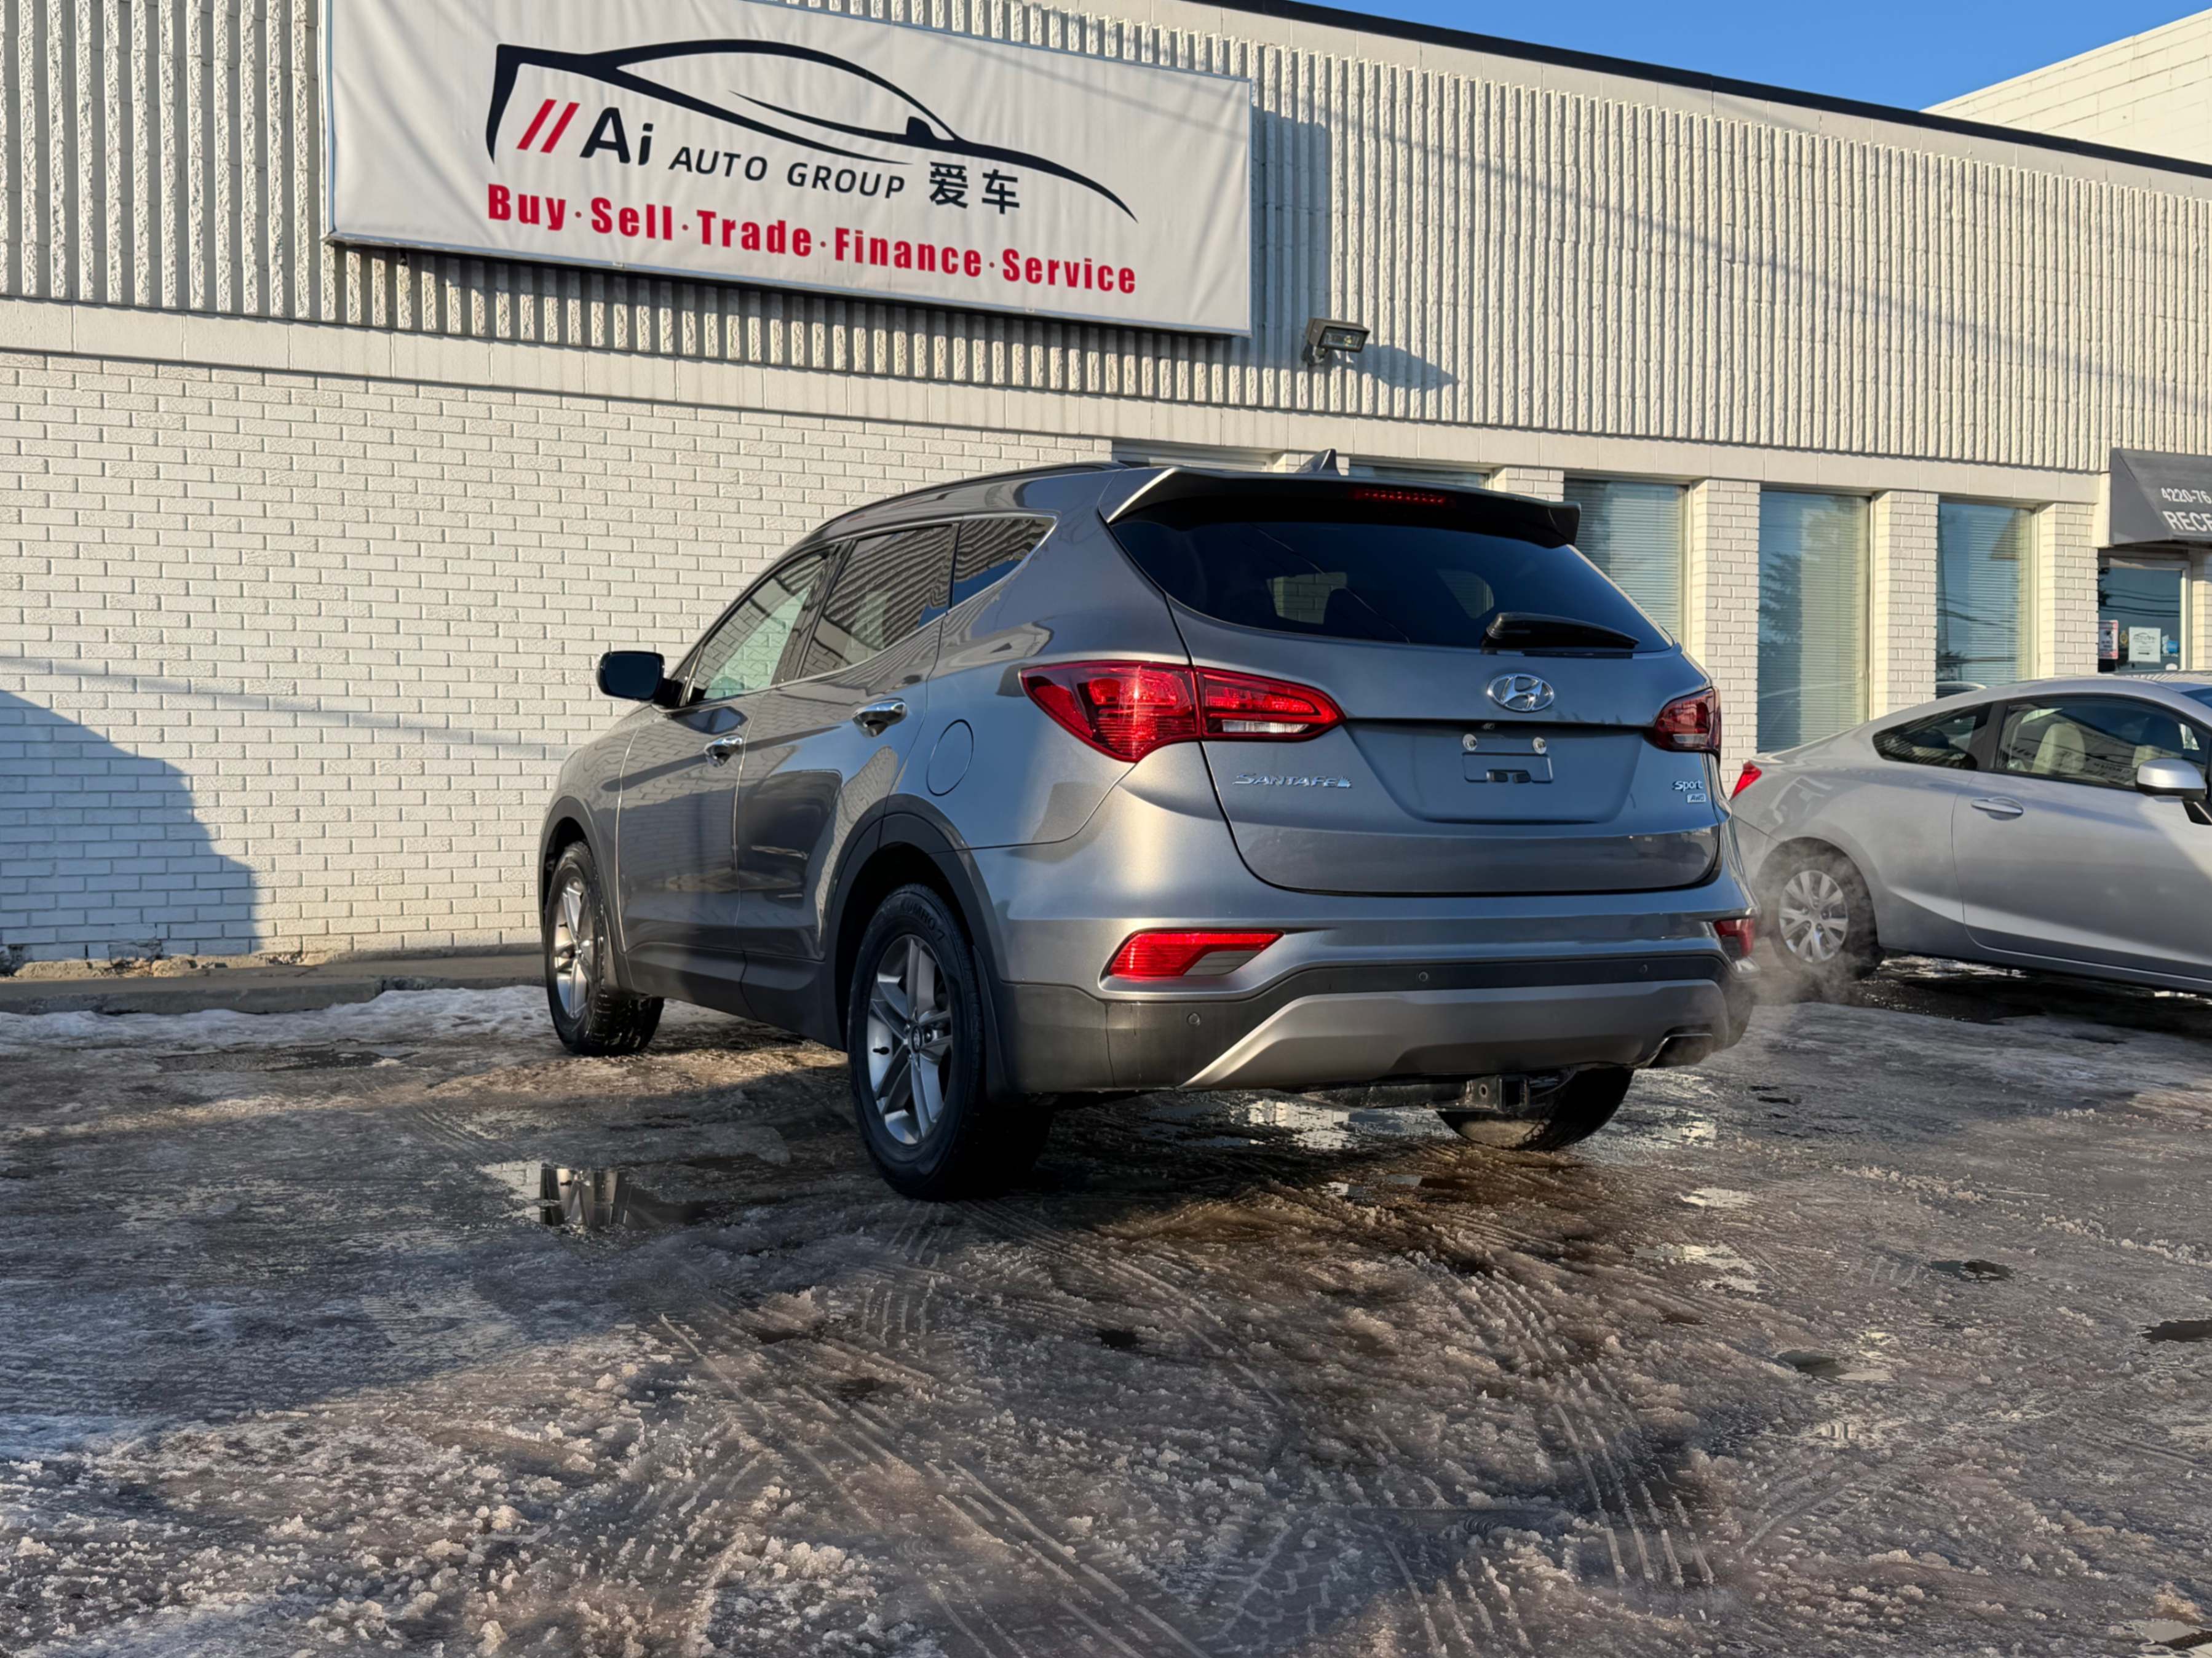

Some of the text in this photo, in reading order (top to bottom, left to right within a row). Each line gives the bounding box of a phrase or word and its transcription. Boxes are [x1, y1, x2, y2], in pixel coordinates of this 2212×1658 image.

[668, 146, 768, 181] AUTO
[787, 162, 905, 199] GROUP
[929, 161, 1020, 215] 爱车
[488, 183, 1136, 295] Buy Sell Trade Finance Service
[1673, 779, 1703, 792] Sport
